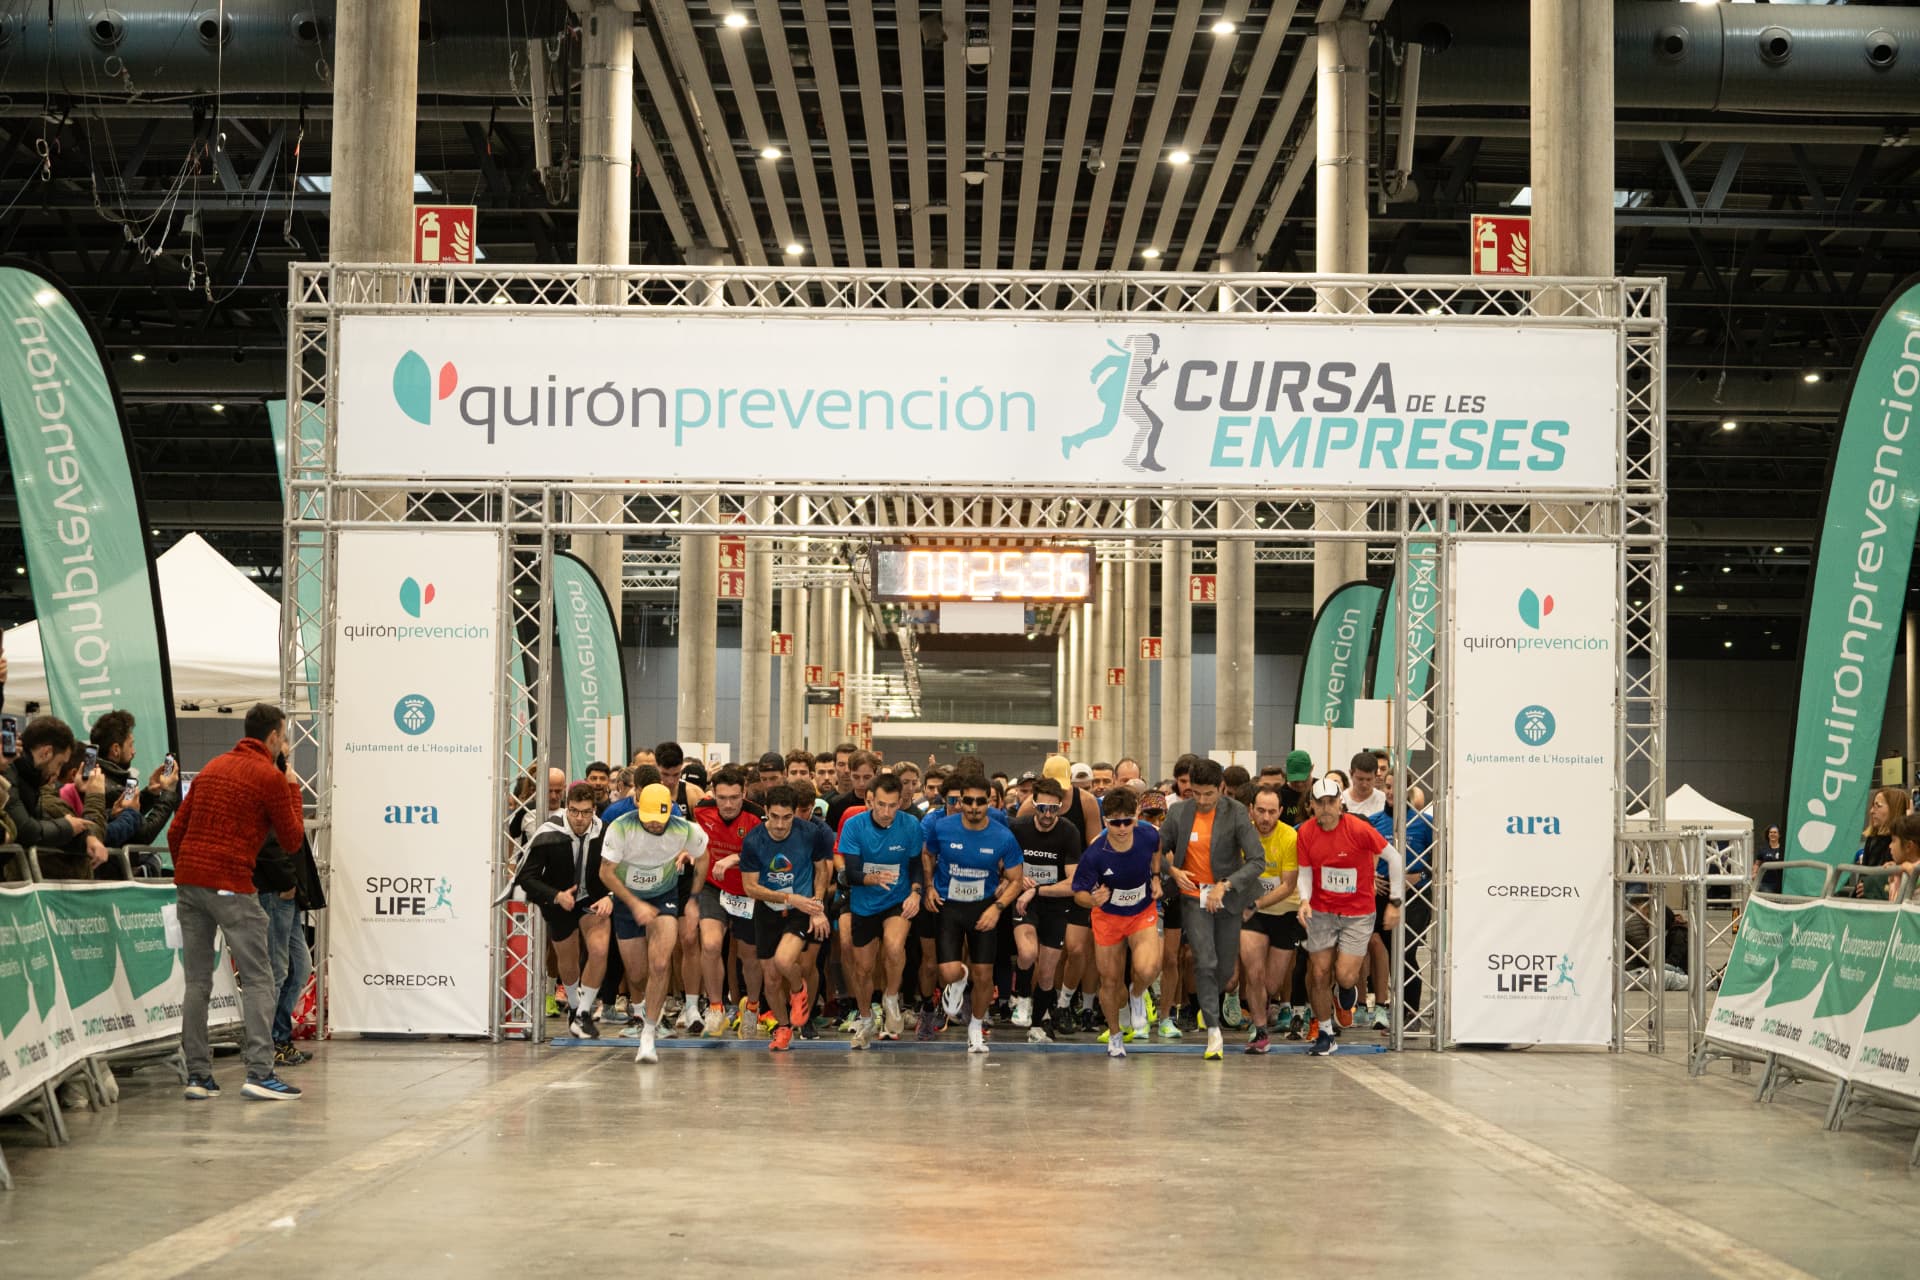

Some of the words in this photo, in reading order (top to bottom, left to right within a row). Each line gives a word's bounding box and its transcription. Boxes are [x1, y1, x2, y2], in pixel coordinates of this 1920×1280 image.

[1174, 359, 1397, 413] CURSA
[1406, 394, 1434, 413] DE
[1444, 395, 1486, 413] LES
[459, 373, 1036, 447] quirónprevención
[1209, 416, 1570, 471] EMPRESES
[344, 624, 489, 641] quirónprevención
[1464, 635, 1609, 653] quirónprevención
[1323, 608, 1361, 726] evención
[345, 742, 404, 753] Ajuntament
[407, 743, 419, 752] de
[1466, 753, 1525, 764] Ajuntament
[1528, 754, 1540, 763] de
[384, 804, 439, 824] ara
[1506, 815, 1561, 834] ara
[1023, 850, 1058, 859] SOCOTEC
[366, 877, 436, 894] SPORT
[1327, 876, 1349, 885] 3141
[375, 897, 426, 915] LIFE
[1488, 955, 1557, 971] SPORT
[1497, 974, 1548, 992] LIFE
